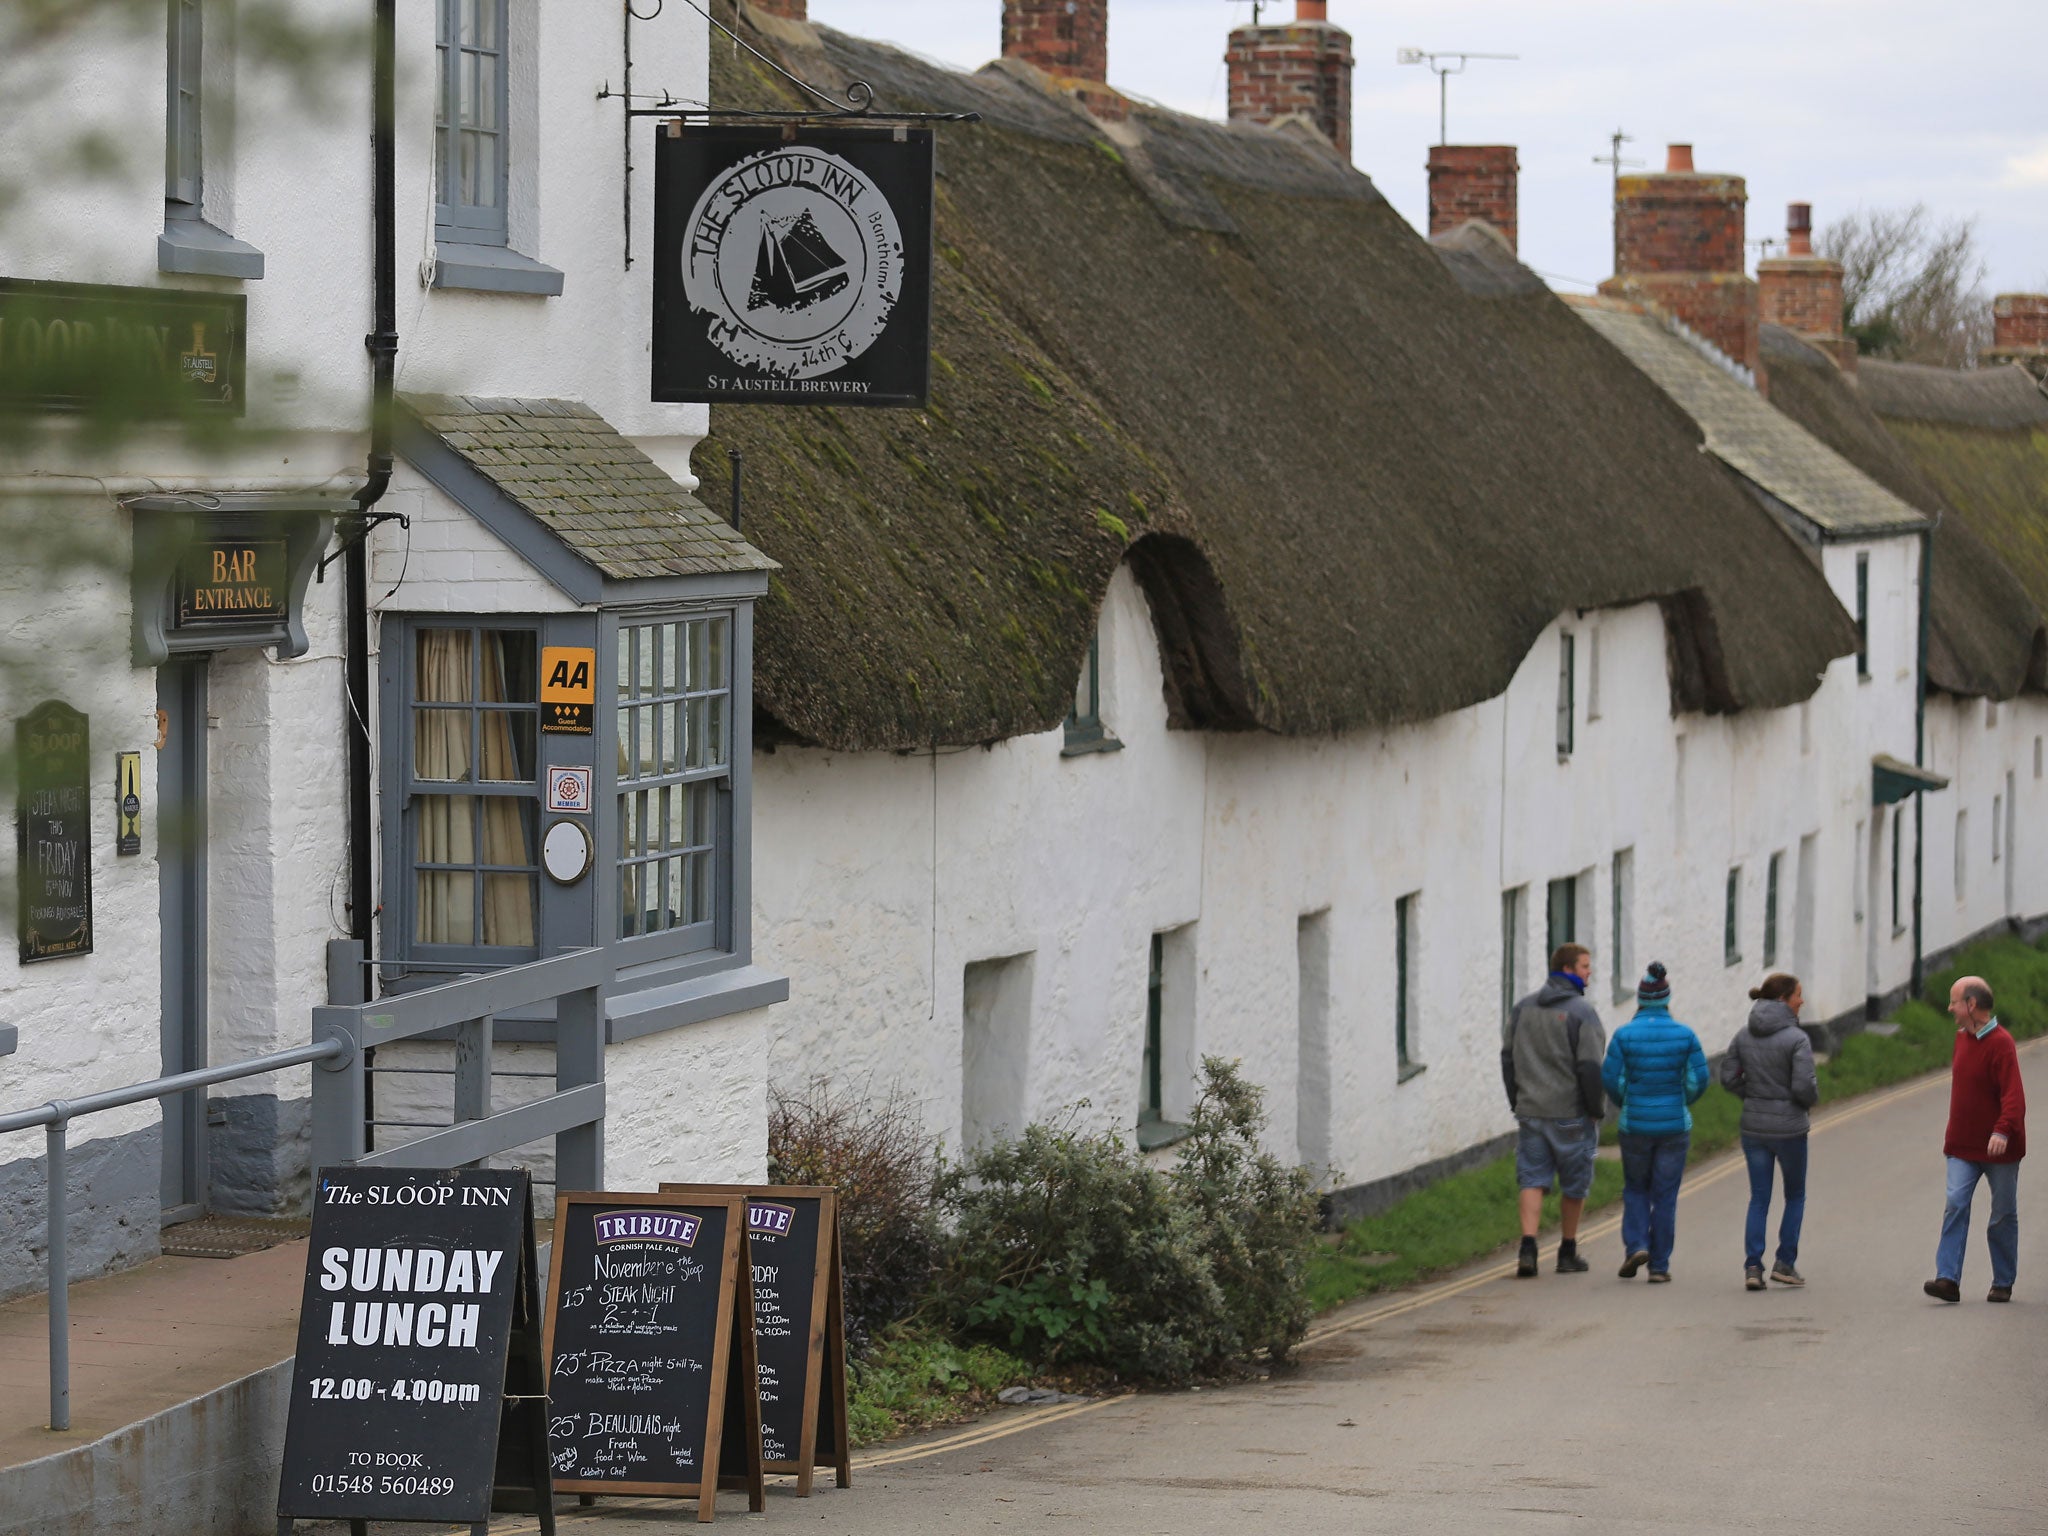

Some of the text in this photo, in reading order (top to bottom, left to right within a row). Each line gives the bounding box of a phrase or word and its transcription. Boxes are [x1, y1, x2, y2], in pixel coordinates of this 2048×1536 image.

[692, 157, 865, 257] THE SLOOP INN
[802, 345, 837, 367] 14th
[732, 377, 798, 391] AUSTELL
[801, 382, 871, 393] BREWERY
[212, 549, 257, 583] BAR
[194, 588, 272, 611] ENTRANCE
[547, 660, 589, 690] AA
[542, 724, 592, 733] Accommodation
[48, 820, 63, 836] THIS
[38, 840, 78, 880] FRIDAY
[325, 1184, 512, 1206] The SLOOP INN
[600, 1216, 695, 1241] TRIBUTE
[749, 1208, 789, 1230] UTE
[610, 1243, 643, 1252] CORNISH
[665, 1246, 679, 1254] ALE
[320, 1247, 503, 1293] SUNDAY
[595, 1251, 664, 1280] November
[677, 1256, 693, 1266] the
[599, 1284, 639, 1305] STEAK
[328, 1301, 480, 1347] LUNCH
[642, 1356, 663, 1373] night
[310, 1378, 370, 1399] 12.00
[391, 1379, 480, 1403] 4.00pm
[585, 1376, 604, 1384] make
[608, 1377, 625, 1389] your
[583, 1413, 661, 1439] BEAUJOLAIS
[663, 1417, 681, 1442] night
[609, 1437, 637, 1449] French
[670, 1446, 692, 1456] Limited
[349, 1452, 423, 1468] TO BOOK
[551, 1446, 578, 1468] harity
[594, 1450, 613, 1463] food
[627, 1451, 648, 1462] Wine
[312, 1474, 455, 1496] 01548 560489
